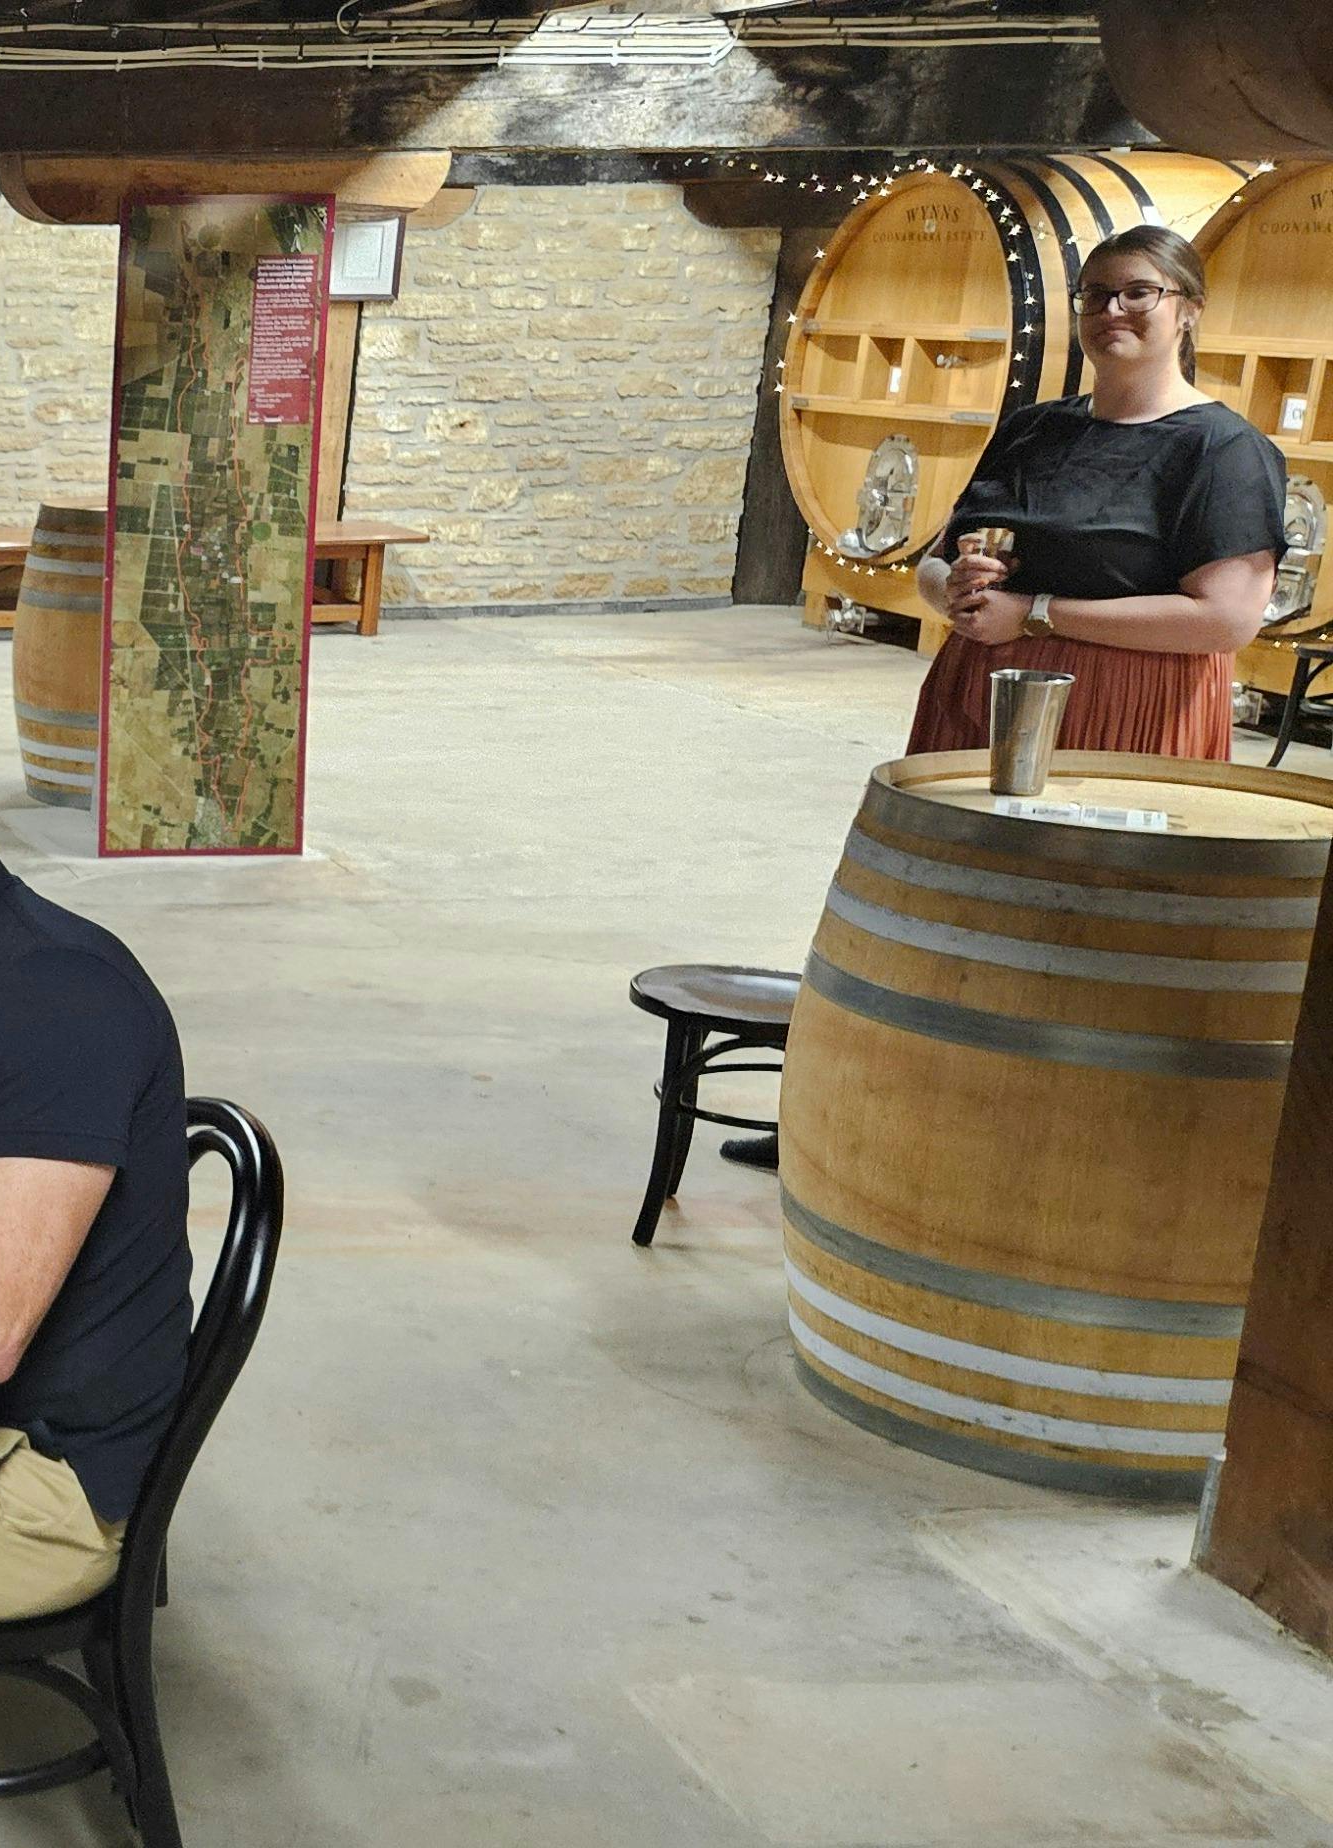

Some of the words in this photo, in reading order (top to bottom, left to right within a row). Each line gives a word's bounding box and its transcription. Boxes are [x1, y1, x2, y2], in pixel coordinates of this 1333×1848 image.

[906, 203, 961, 223] WYNNS
[872, 230, 942, 243] COONAWARRA
[946, 230, 988, 242] ESTATE
